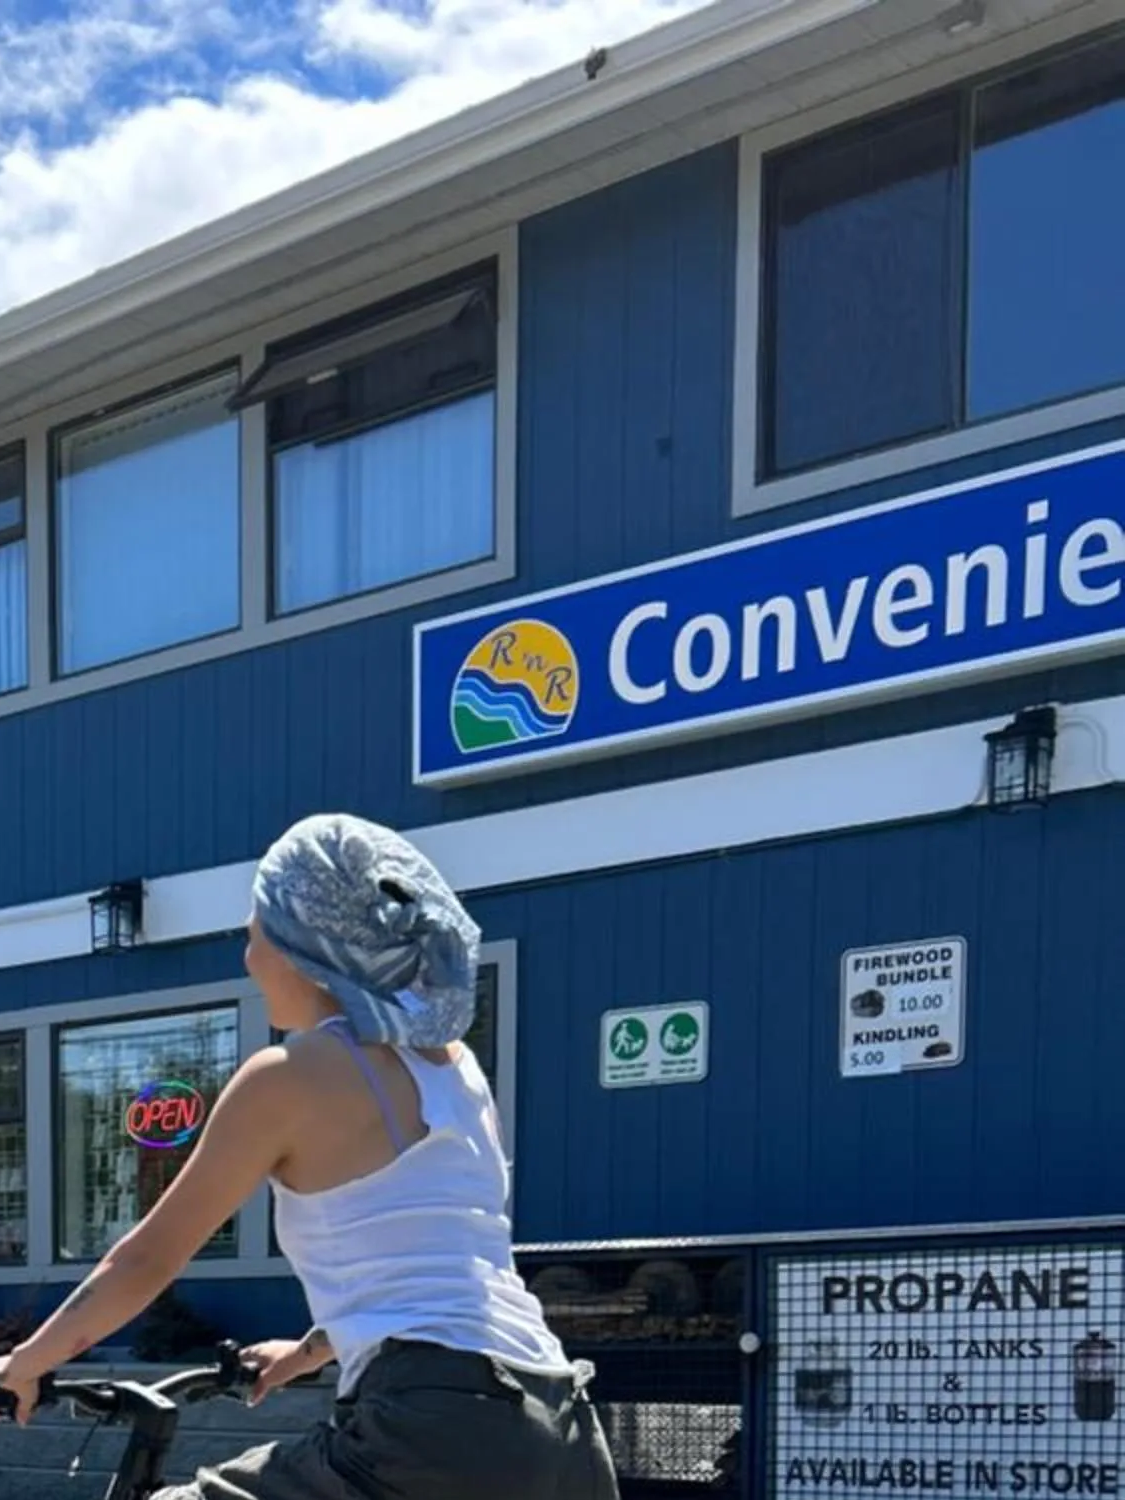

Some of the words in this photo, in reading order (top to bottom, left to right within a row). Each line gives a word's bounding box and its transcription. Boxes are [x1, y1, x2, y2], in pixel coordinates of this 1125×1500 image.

[608, 499, 1125, 705] Convenie
[491, 631, 517, 670] R
[545, 666, 572, 704] R
[853, 947, 953, 972] FIREWOOD
[876, 966, 952, 986] BUNDLE
[899, 994, 943, 1012] 10.00
[853, 1024, 939, 1045] KINDLING
[850, 1050, 884, 1067] 5.00
[129, 1097, 199, 1131] OPEN
[823, 1267, 1089, 1315] PROPANE
[868, 1340, 898, 1360] 20
[949, 1338, 1043, 1359] TANKS
[942, 1372, 964, 1393] &
[926, 1403, 1048, 1426] BOTTLES
[785, 1457, 954, 1489] AVAILABLE
[965, 1460, 999, 1491] IN
[1009, 1461, 1119, 1494] STORE
